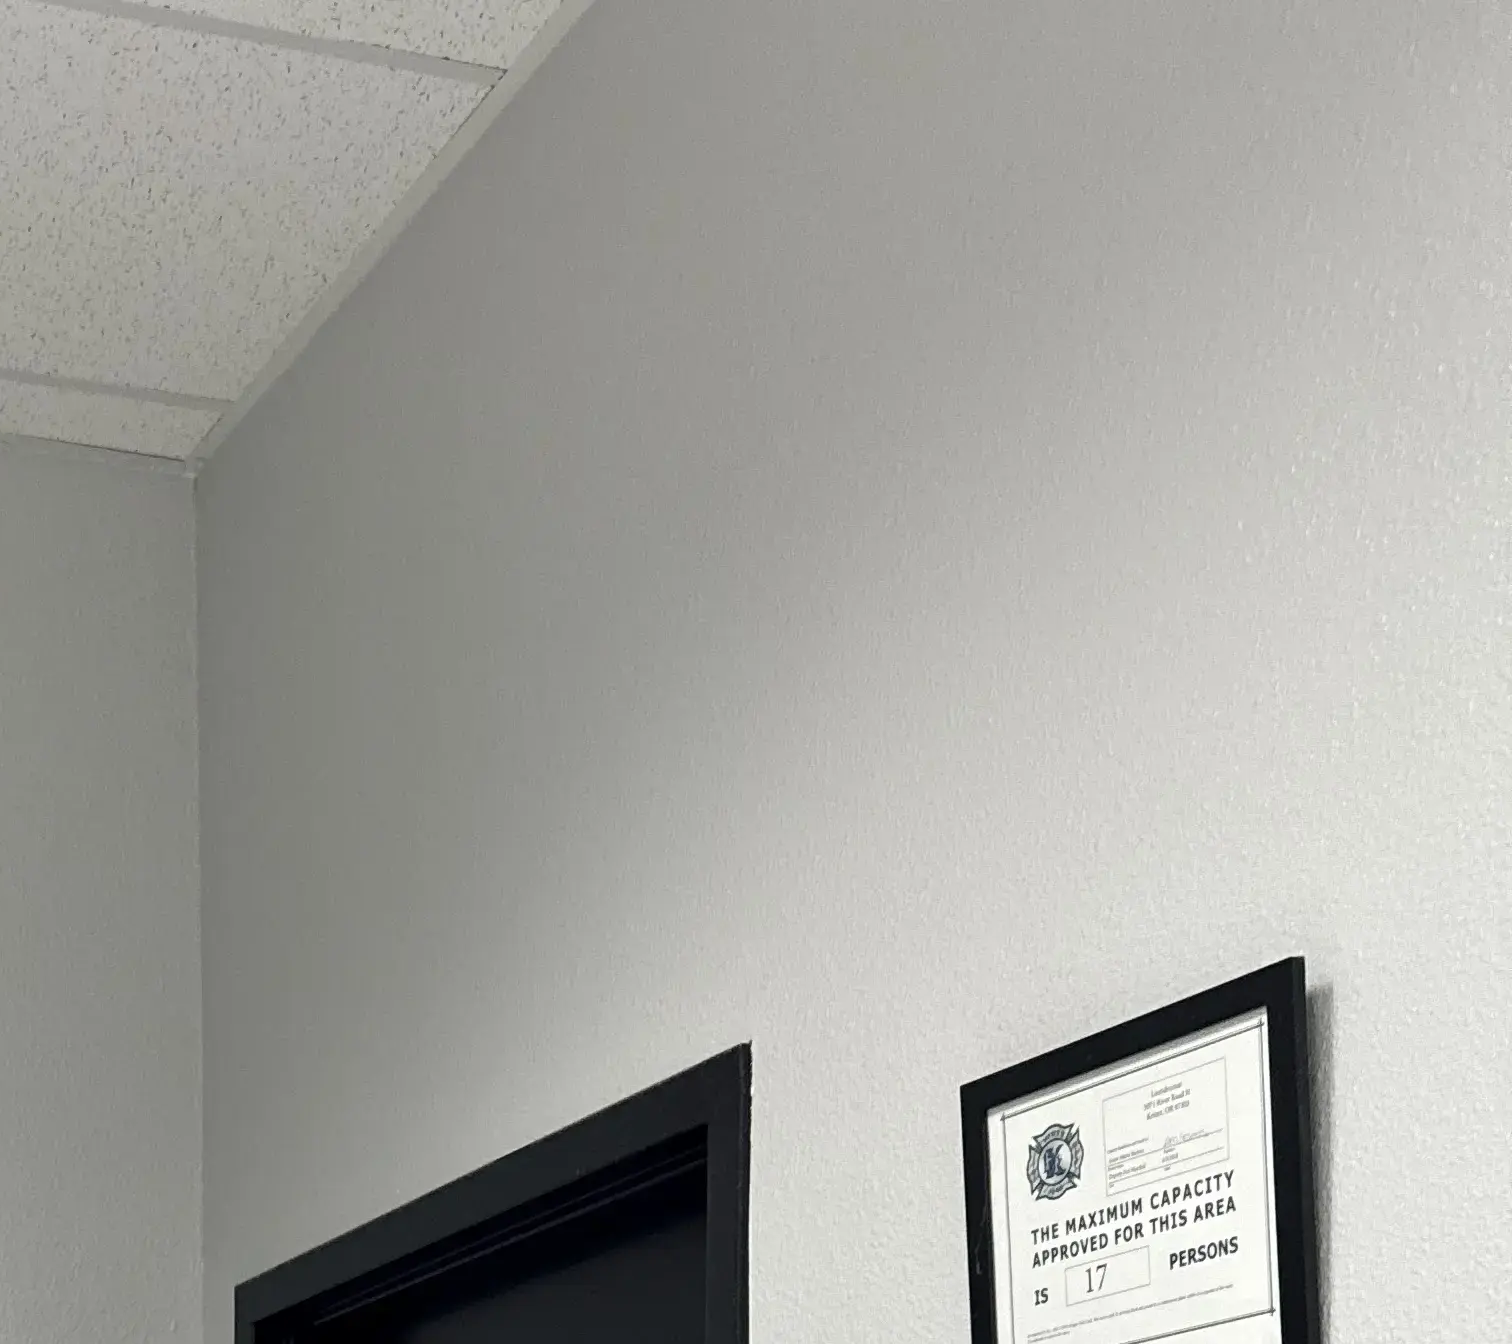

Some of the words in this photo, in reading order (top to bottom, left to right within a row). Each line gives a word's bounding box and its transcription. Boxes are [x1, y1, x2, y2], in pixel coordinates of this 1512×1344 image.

[1031, 1224, 1059, 1246] THE
[1065, 1198, 1142, 1236] MAXIMUM
[1149, 1169, 1234, 1209] CAPACITY
[1032, 1233, 1109, 1269] APPROVED
[1114, 1222, 1144, 1244] FOR
[1149, 1209, 1187, 1235] THIS
[1193, 1196, 1236, 1223] AREA
[1034, 1288, 1049, 1306] IS
[1084, 1263, 1107, 1294] 17
[1169, 1236, 1239, 1270] PERSONS
